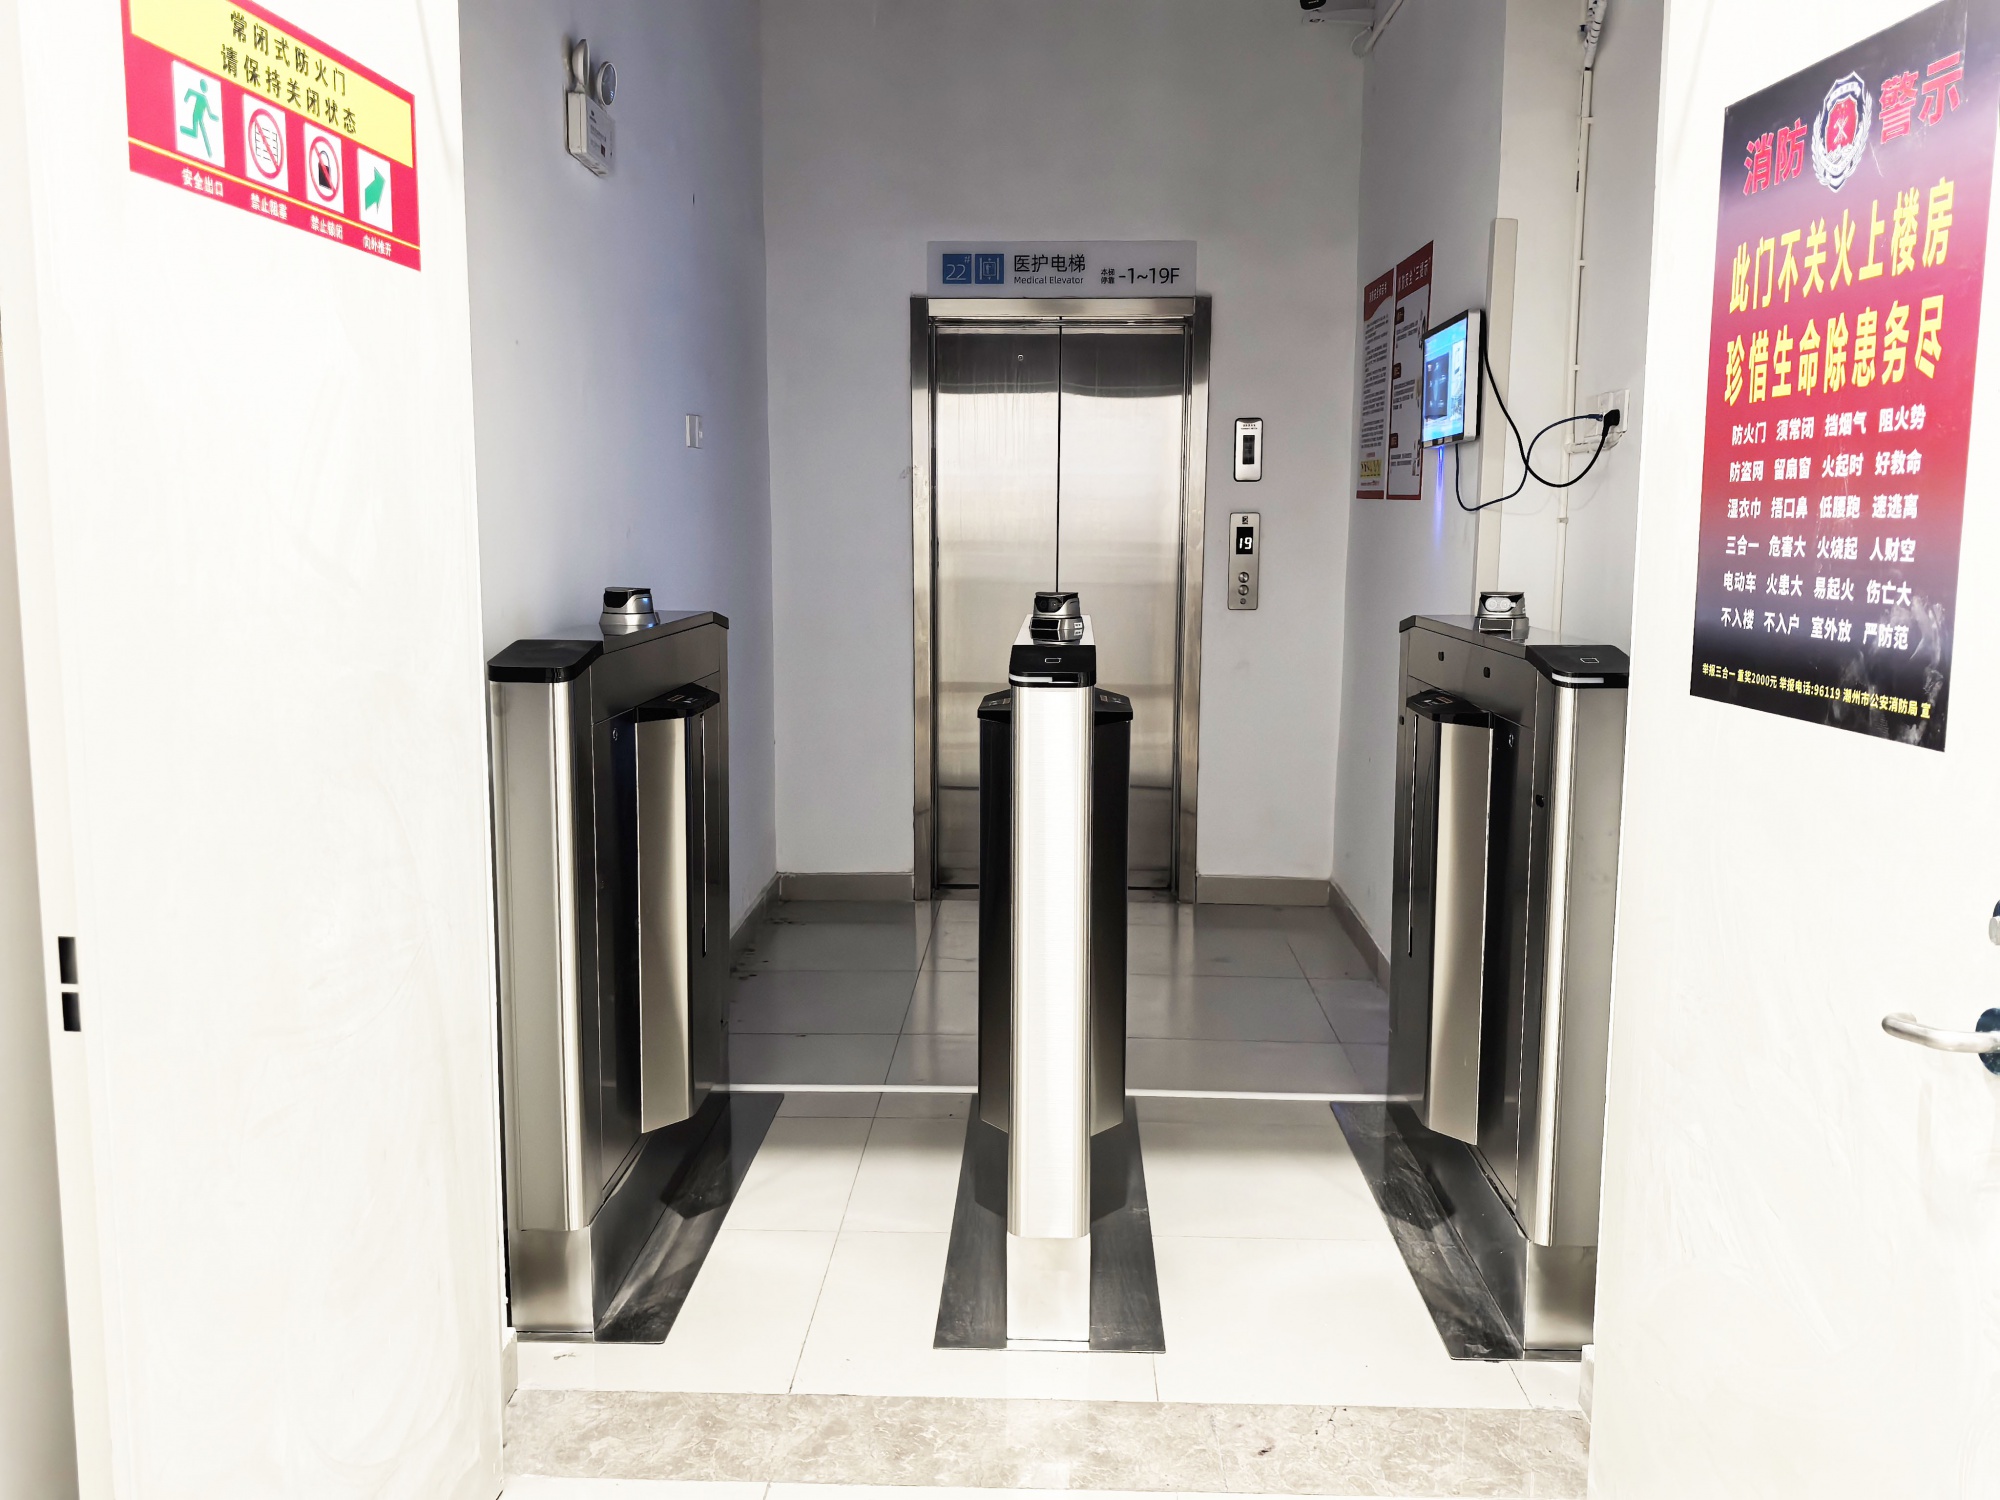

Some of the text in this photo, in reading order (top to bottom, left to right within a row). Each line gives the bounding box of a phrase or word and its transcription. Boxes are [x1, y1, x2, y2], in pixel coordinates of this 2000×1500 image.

[231, 11, 346, 96] 常闭式防火门
[221, 44, 357, 134] 请保持关闭状态
[1743, 51, 1964, 195] 消防 警示
[181, 168, 224, 197] 安全出口
[251, 193, 287, 220] 禁止阻塞
[1729, 177, 1955, 314] 此门不关火上楼房
[1014, 254, 1086, 273] 医护电梯
[1014, 276, 1084, 284] Medical Elevator
[1724, 295, 1944, 406] 珍惜生命除患务尽
[1731, 403, 1926, 446] 防火门 须常闭 挡烟气 阻火势
[1729, 448, 1922, 482] 防盗网 留扇窗 火起时 好救命
[1727, 493, 1919, 519] 湿衣巾 捂口鼻 低腰跑 速逃离
[1239, 537, 1253, 549] 19
[1725, 535, 1916, 563] 三合一 危害大 火烧起 人财空
[1723, 571, 1912, 606] 电动车 火患大 易起火 伤亡大
[1720, 607, 1909, 650] 不入楼 不入户 室外放 严防范
[1702, 662, 1931, 719] 举报三合一 重奖2000元 举报电话:96119 潮州市公安消防局 宣
